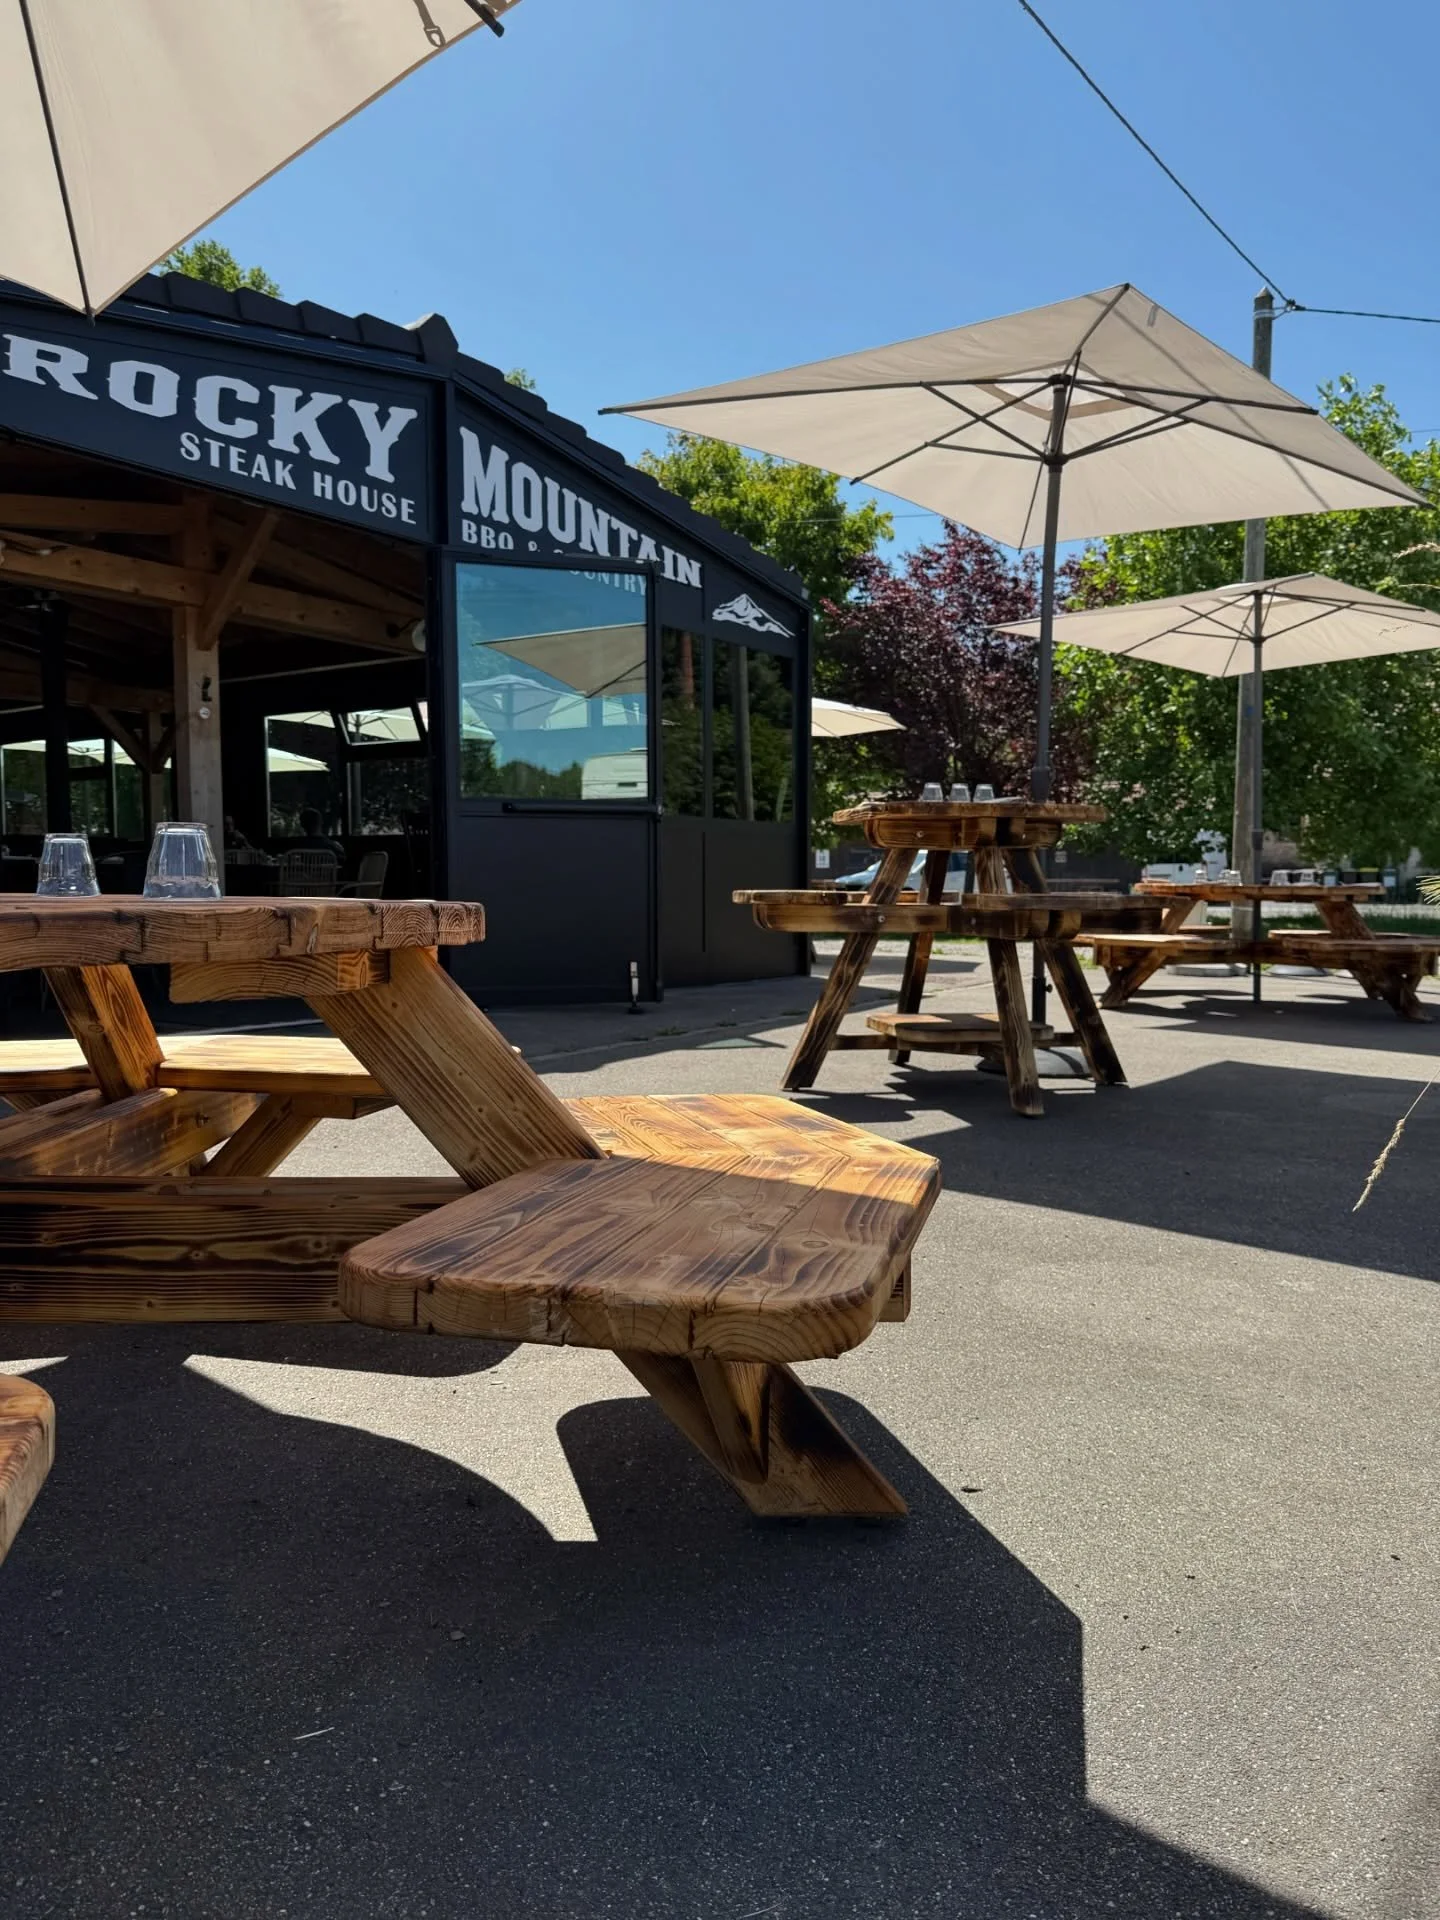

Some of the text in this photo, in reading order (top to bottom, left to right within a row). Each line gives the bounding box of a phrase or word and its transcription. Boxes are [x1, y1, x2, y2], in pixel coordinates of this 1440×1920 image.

[2, 333, 418, 484] ROCKY
[180, 431, 417, 525] STEAK HOUSE
[459, 426, 703, 589] MOUNTAIN
[461, 518, 514, 551] BBQ
